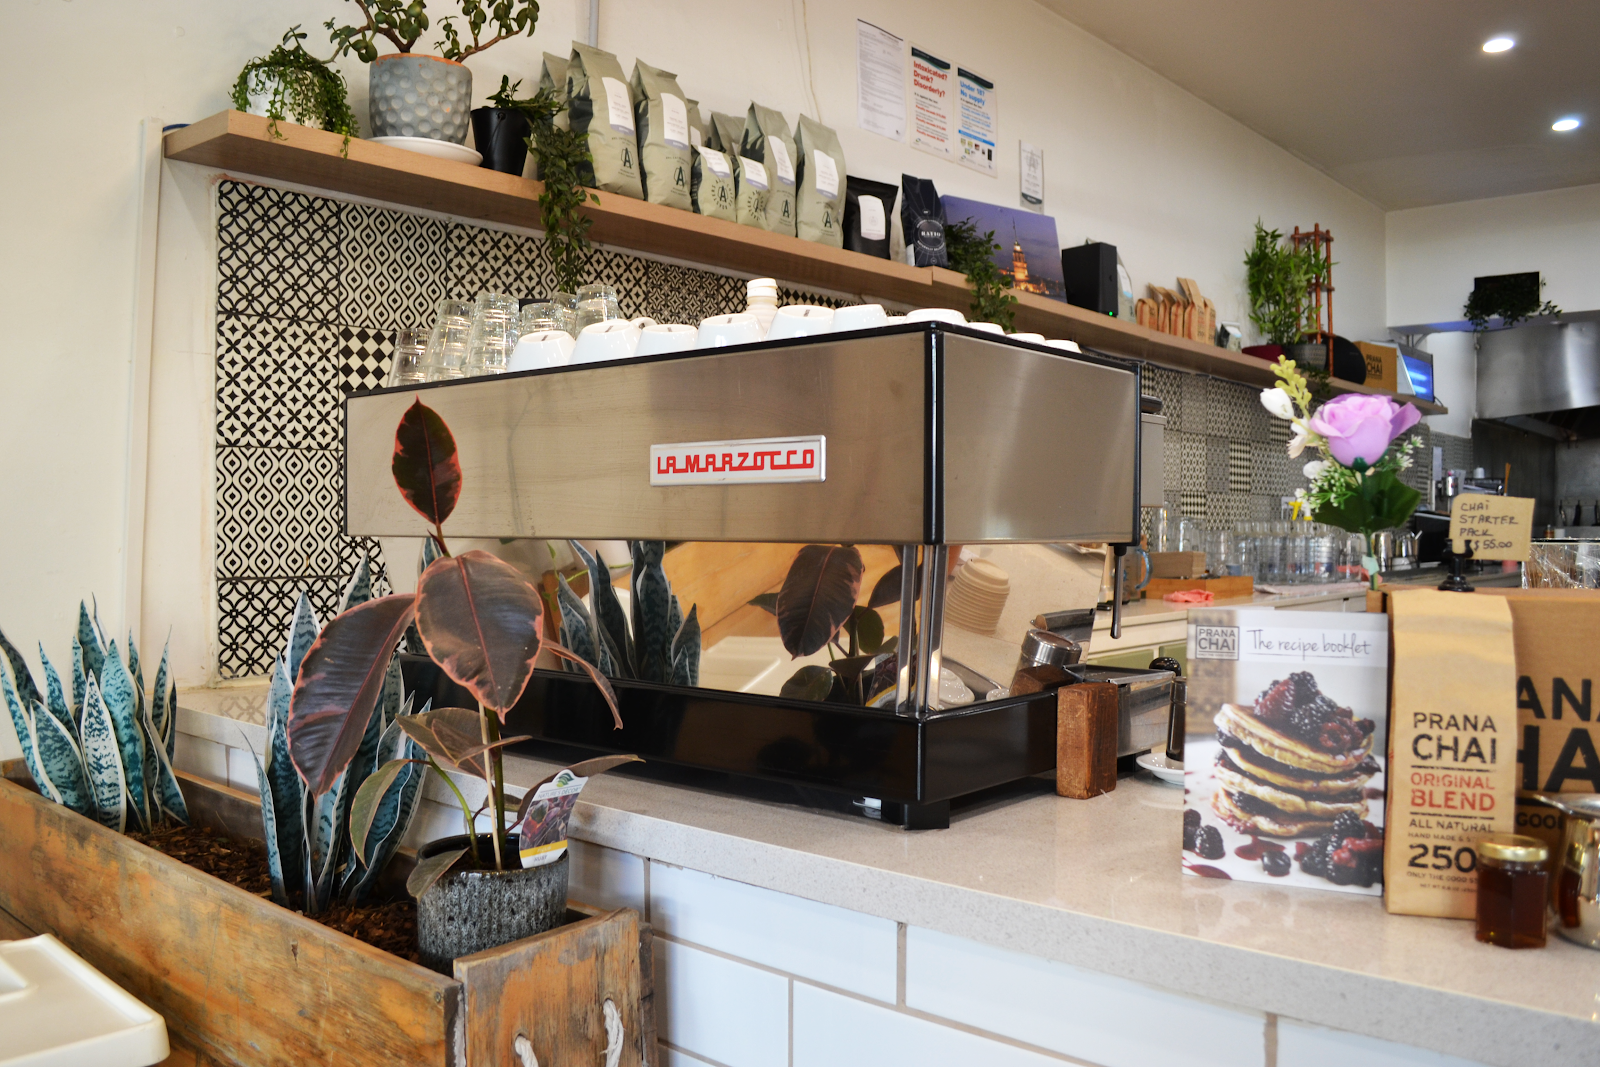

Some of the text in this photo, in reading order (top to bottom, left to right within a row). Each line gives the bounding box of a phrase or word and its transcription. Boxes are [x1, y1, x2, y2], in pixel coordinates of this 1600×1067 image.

[914, 60, 948, 80] Intoxicated?
[914, 70, 934, 83] Drunk?
[914, 78, 946, 98] Disorderly?
[960, 80, 975, 92] Under
[968, 94, 985, 106] supply
[623, 147, 632, 169] A
[676, 166, 684, 188] A
[720, 186, 727, 203] A
[783, 199, 790, 218] A
[824, 211, 832, 228] A
[1366, 362, 1383, 375] CHAI
[1459, 514, 1519, 524] STARTER
[1460, 528, 1494, 537] PACK
[1199, 628, 1236, 638] PRANA
[1198, 637, 1236, 651] CHAI
[1246, 629, 1372, 661] The recipe booklet
[1414, 712, 1497, 732] PRANA
[1412, 734, 1497, 765] CHAI
[1410, 772, 1496, 790] ORIGINAL
[1410, 789, 1495, 812] BLEND
[1409, 818, 1495, 833] ALL NATURAL
[1408, 843, 1477, 873] 250
